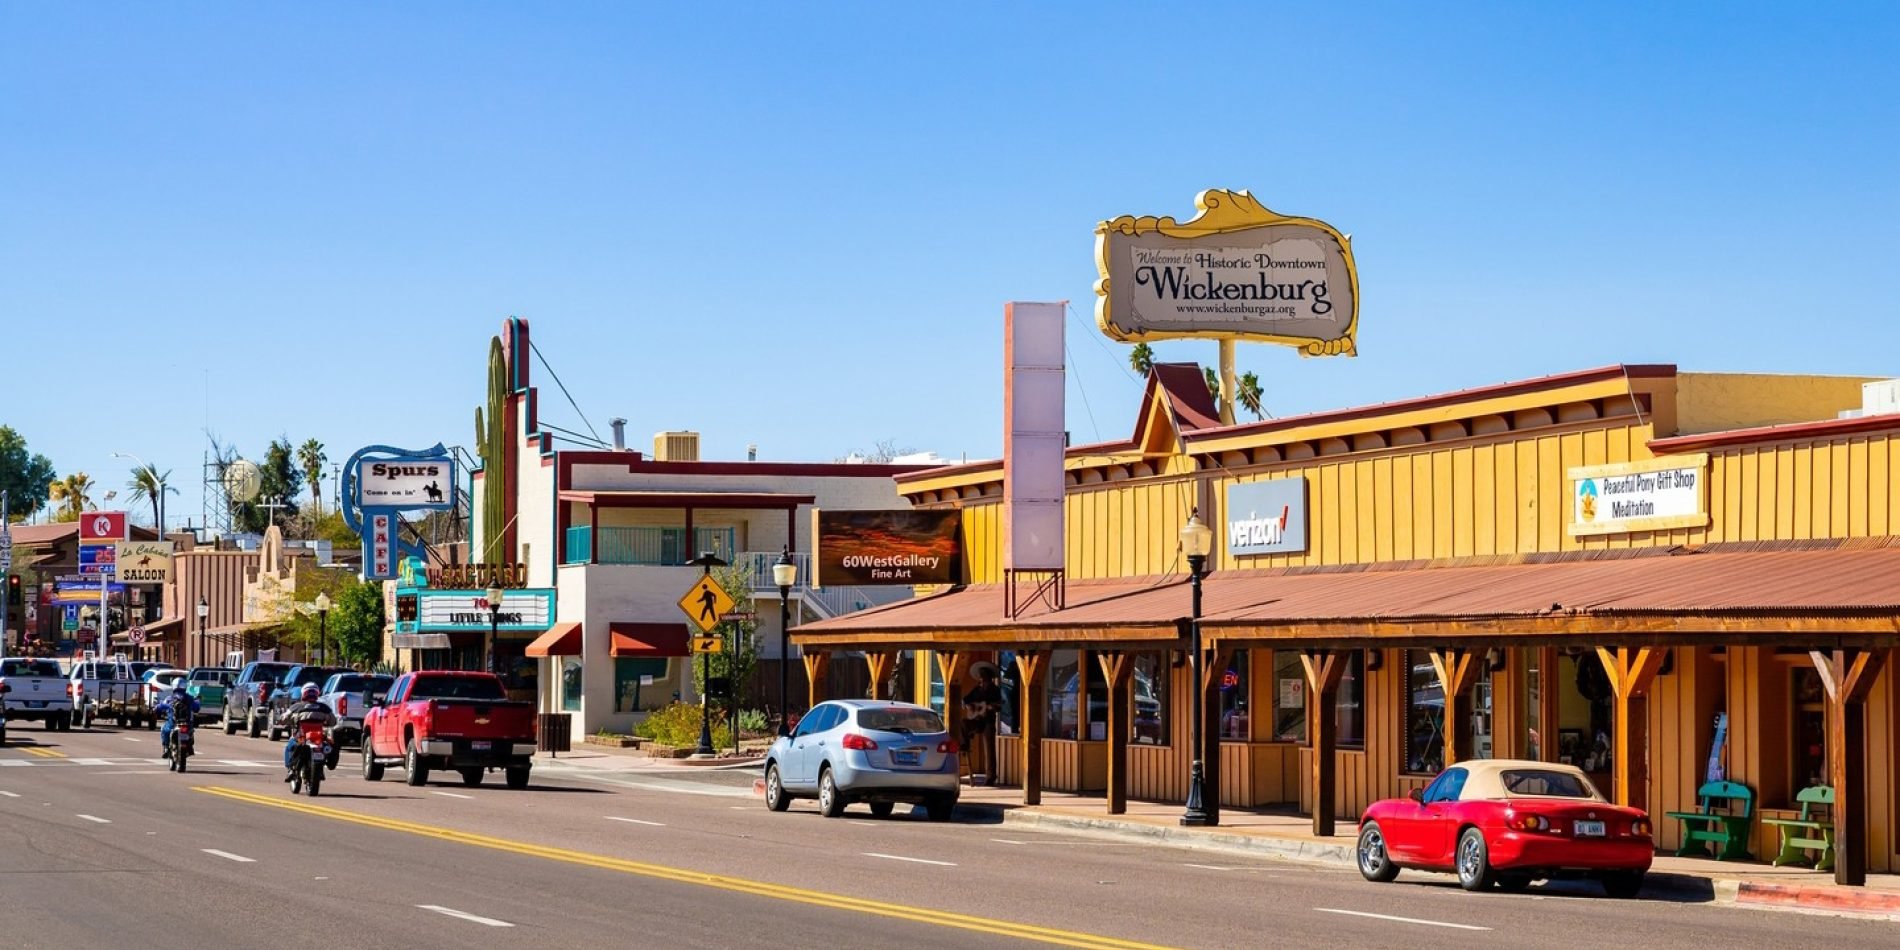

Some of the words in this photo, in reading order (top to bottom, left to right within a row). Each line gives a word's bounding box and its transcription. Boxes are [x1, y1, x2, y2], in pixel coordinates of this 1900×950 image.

[1135, 252, 1182, 264] Welcome
[1183, 252, 1192, 264] to
[1195, 253, 1251, 269] Historic
[1254, 253, 1326, 269] Downtown
[1135, 266, 1332, 315] Wickenburg
[1176, 303, 1296, 317] www.wickenburgaz.org
[372, 463, 439, 480] Spurs
[1603, 475, 1635, 495] Peaceful
[1636, 474, 1655, 494] Pony
[1657, 470, 1673, 490] Gift
[1674, 470, 1695, 490] Shop
[1612, 500, 1654, 519] Meditation
[1229, 511, 1282, 547] verizon
[376, 517, 387, 574] CAFE
[842, 554, 939, 569] 60WestGallery
[123, 569, 166, 581] SALOON
[871, 568, 893, 579] Fine
[894, 568, 912, 578] Art
[1224, 675, 1239, 685] EN
